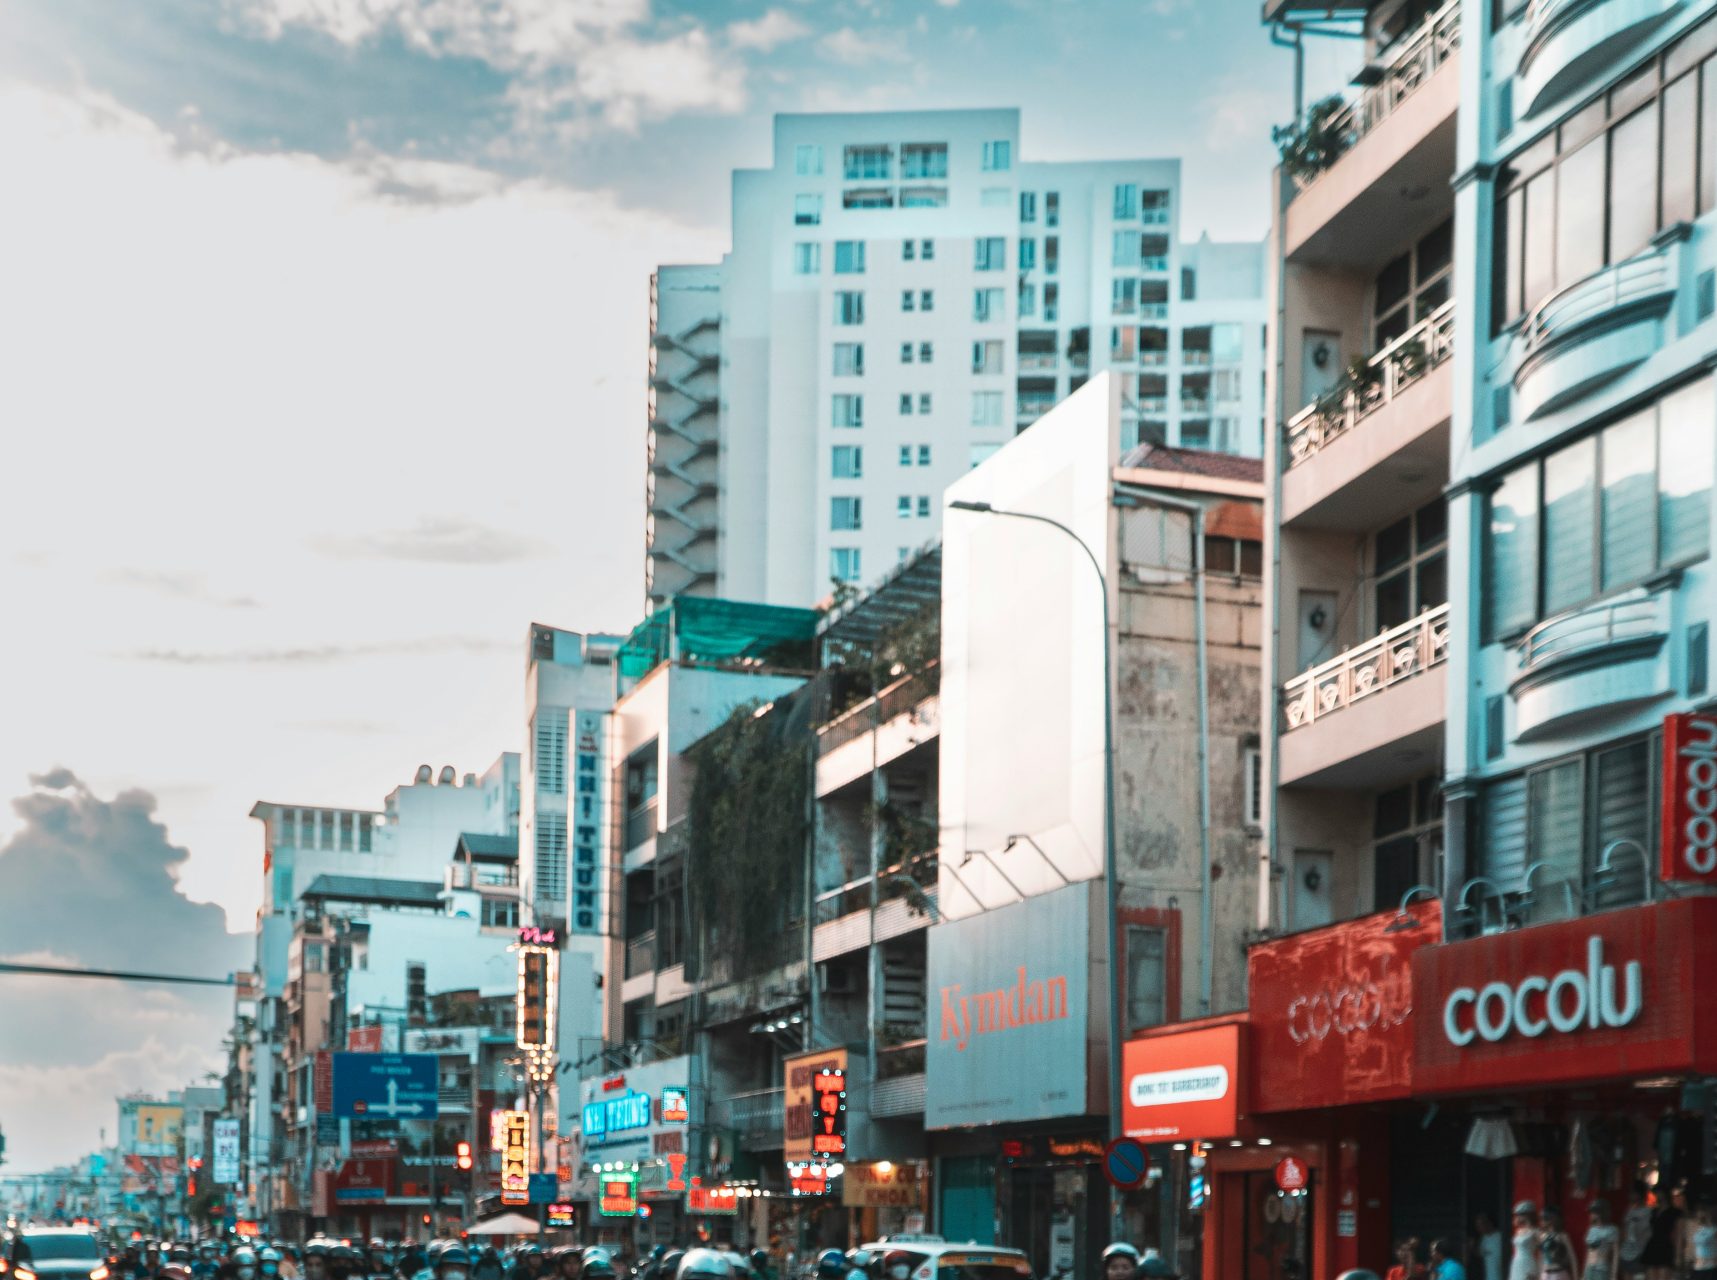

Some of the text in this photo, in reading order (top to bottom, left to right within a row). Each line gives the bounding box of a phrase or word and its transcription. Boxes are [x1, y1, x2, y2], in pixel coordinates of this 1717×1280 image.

[1680, 719, 1717, 874] cocolu
[939, 965, 1070, 1052] Kymdan
[1444, 935, 1642, 1047] cocolu
